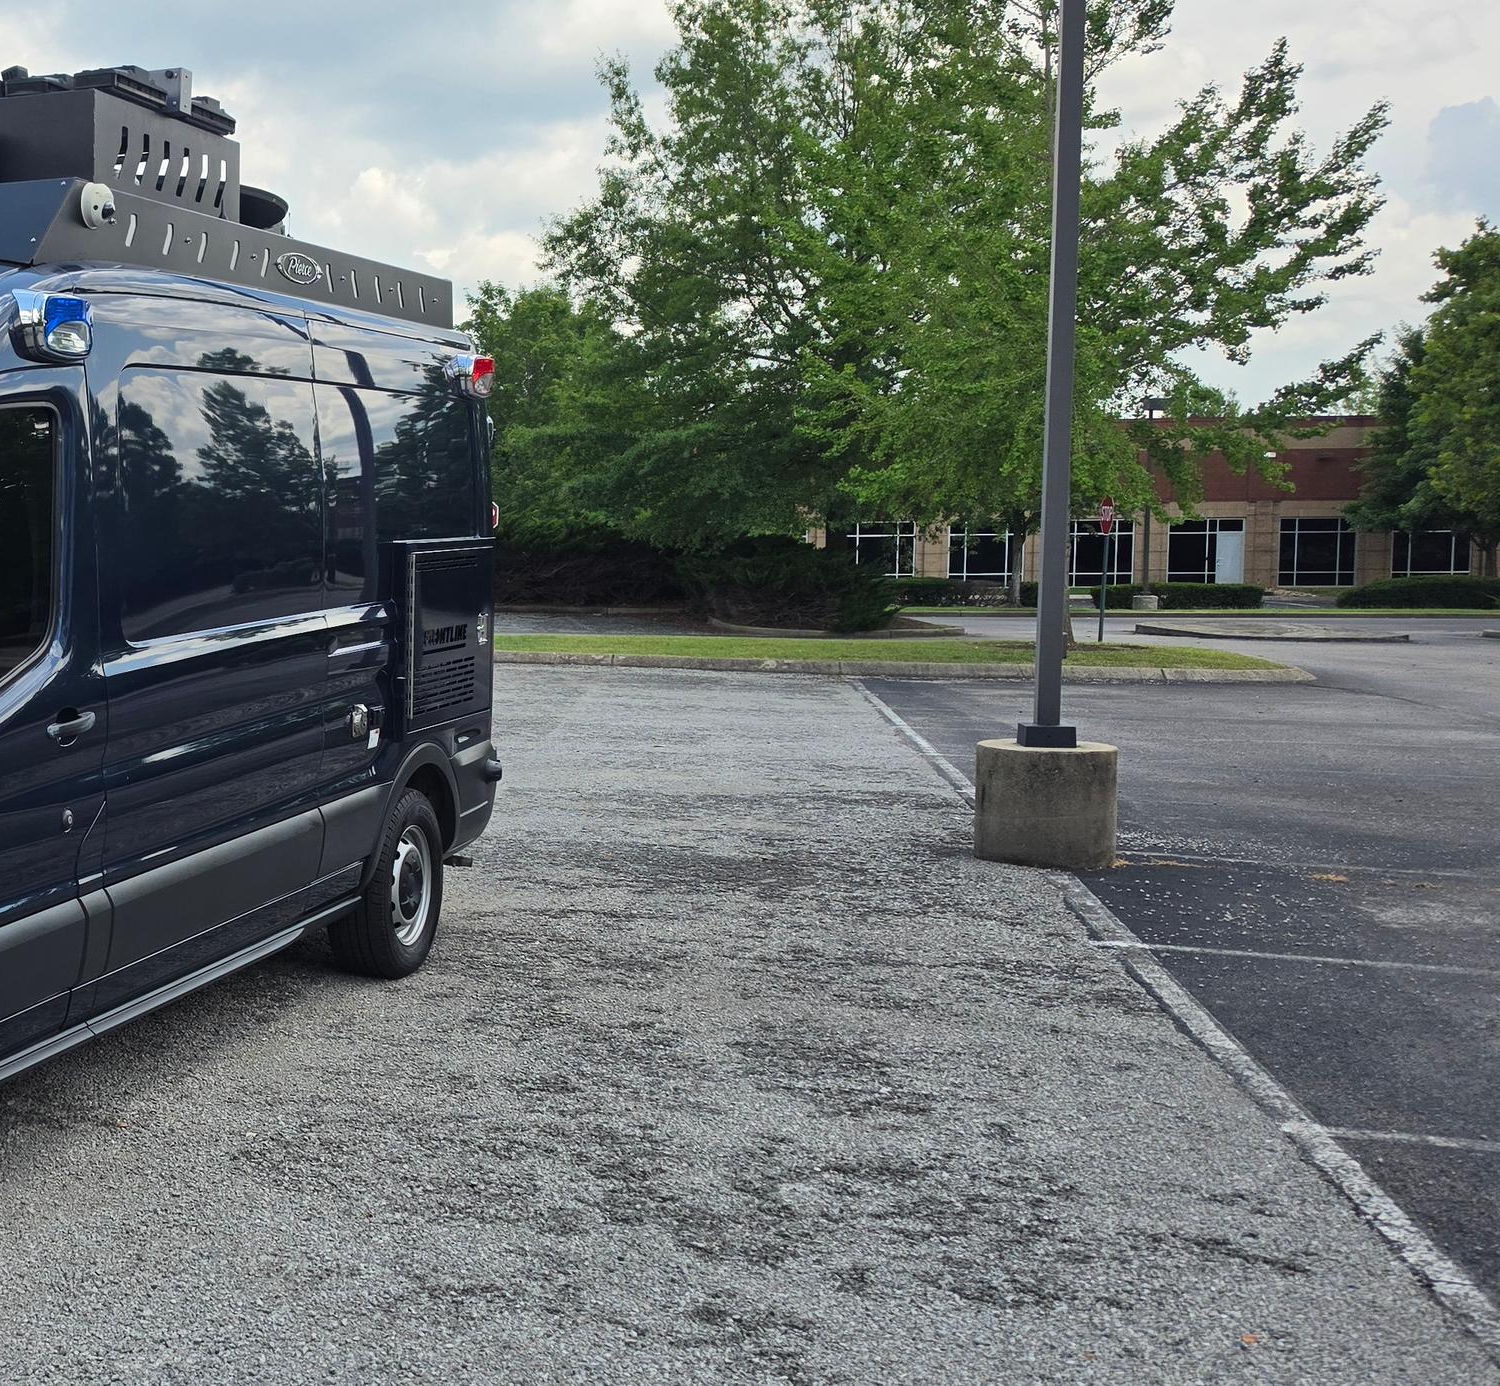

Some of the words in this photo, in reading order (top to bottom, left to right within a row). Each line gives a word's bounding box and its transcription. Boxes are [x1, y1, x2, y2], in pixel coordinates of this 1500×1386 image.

[288, 256, 312, 277] Pierce
[1101, 505, 1113, 522] STOP
[423, 624, 467, 646] FRONTLINE
